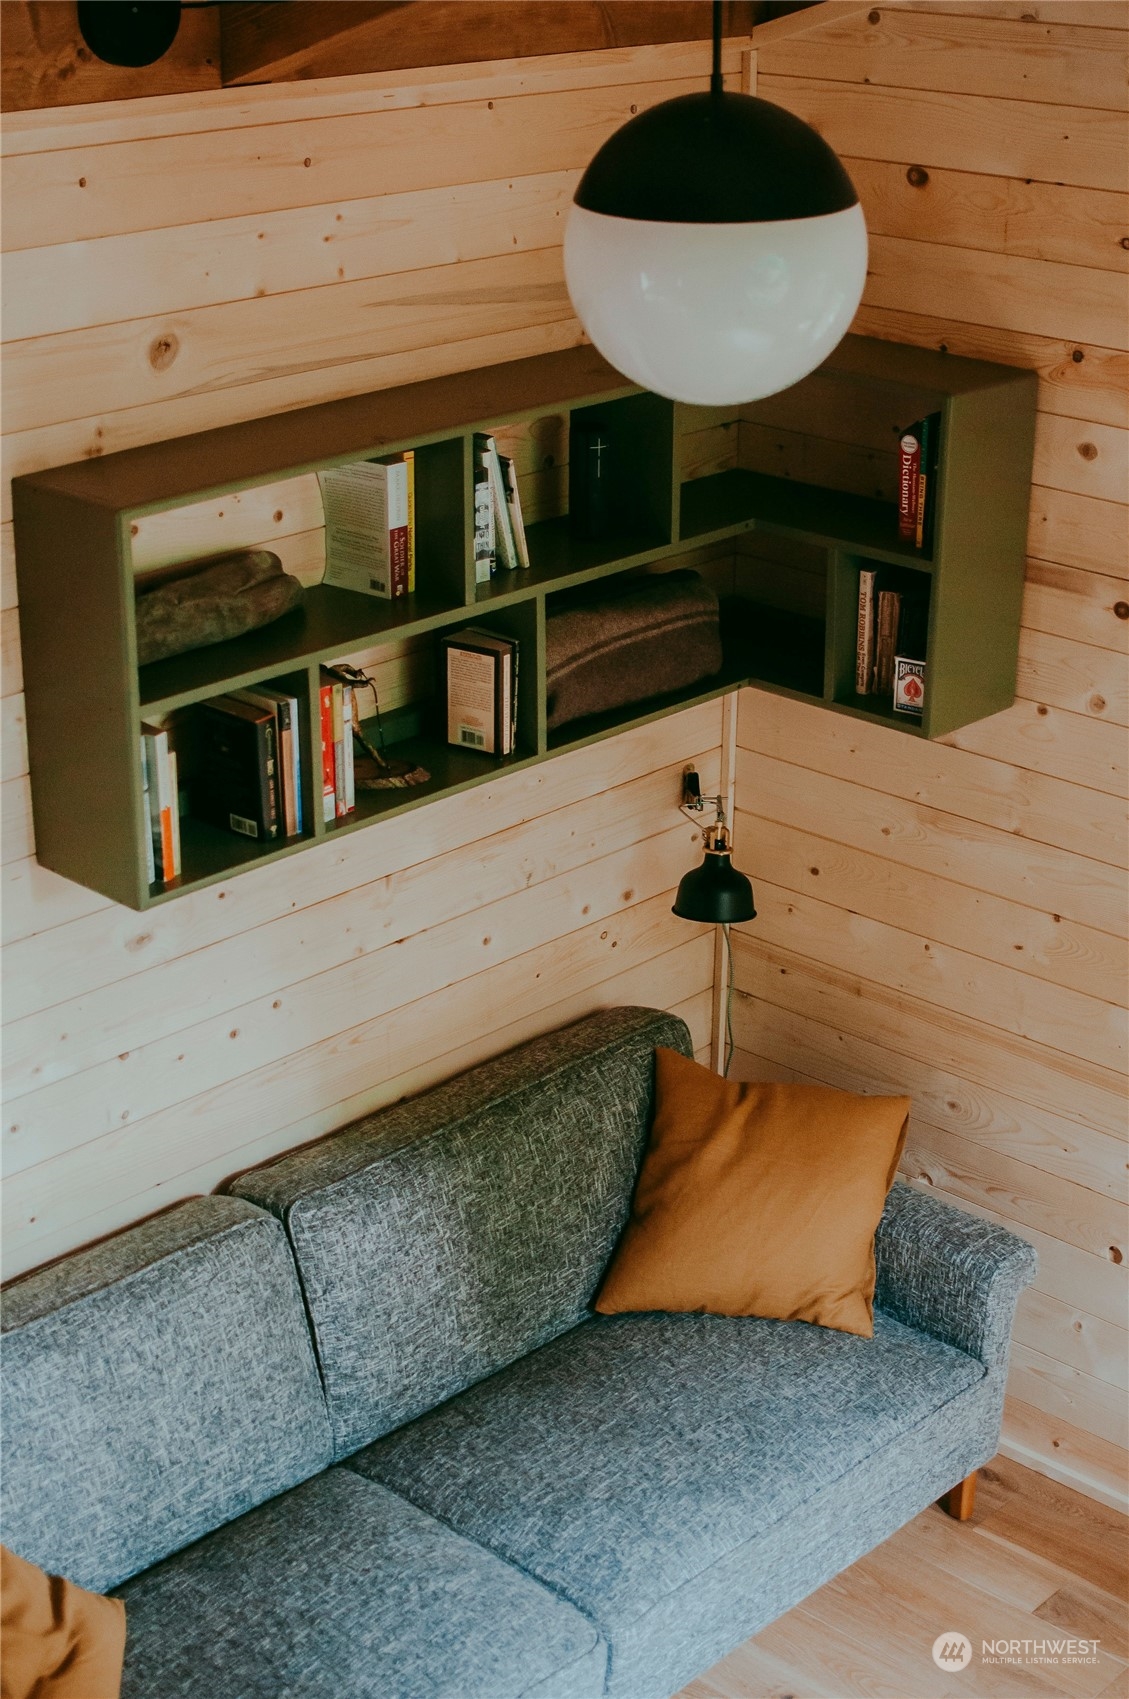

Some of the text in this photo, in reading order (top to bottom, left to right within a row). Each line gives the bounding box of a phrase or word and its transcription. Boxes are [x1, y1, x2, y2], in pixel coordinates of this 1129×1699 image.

[900, 454, 912, 516] Dictionary
[859, 591, 867, 612] TOM
[858, 613, 866, 651] ROBBINS
[899, 662, 924, 678] BICYCL
